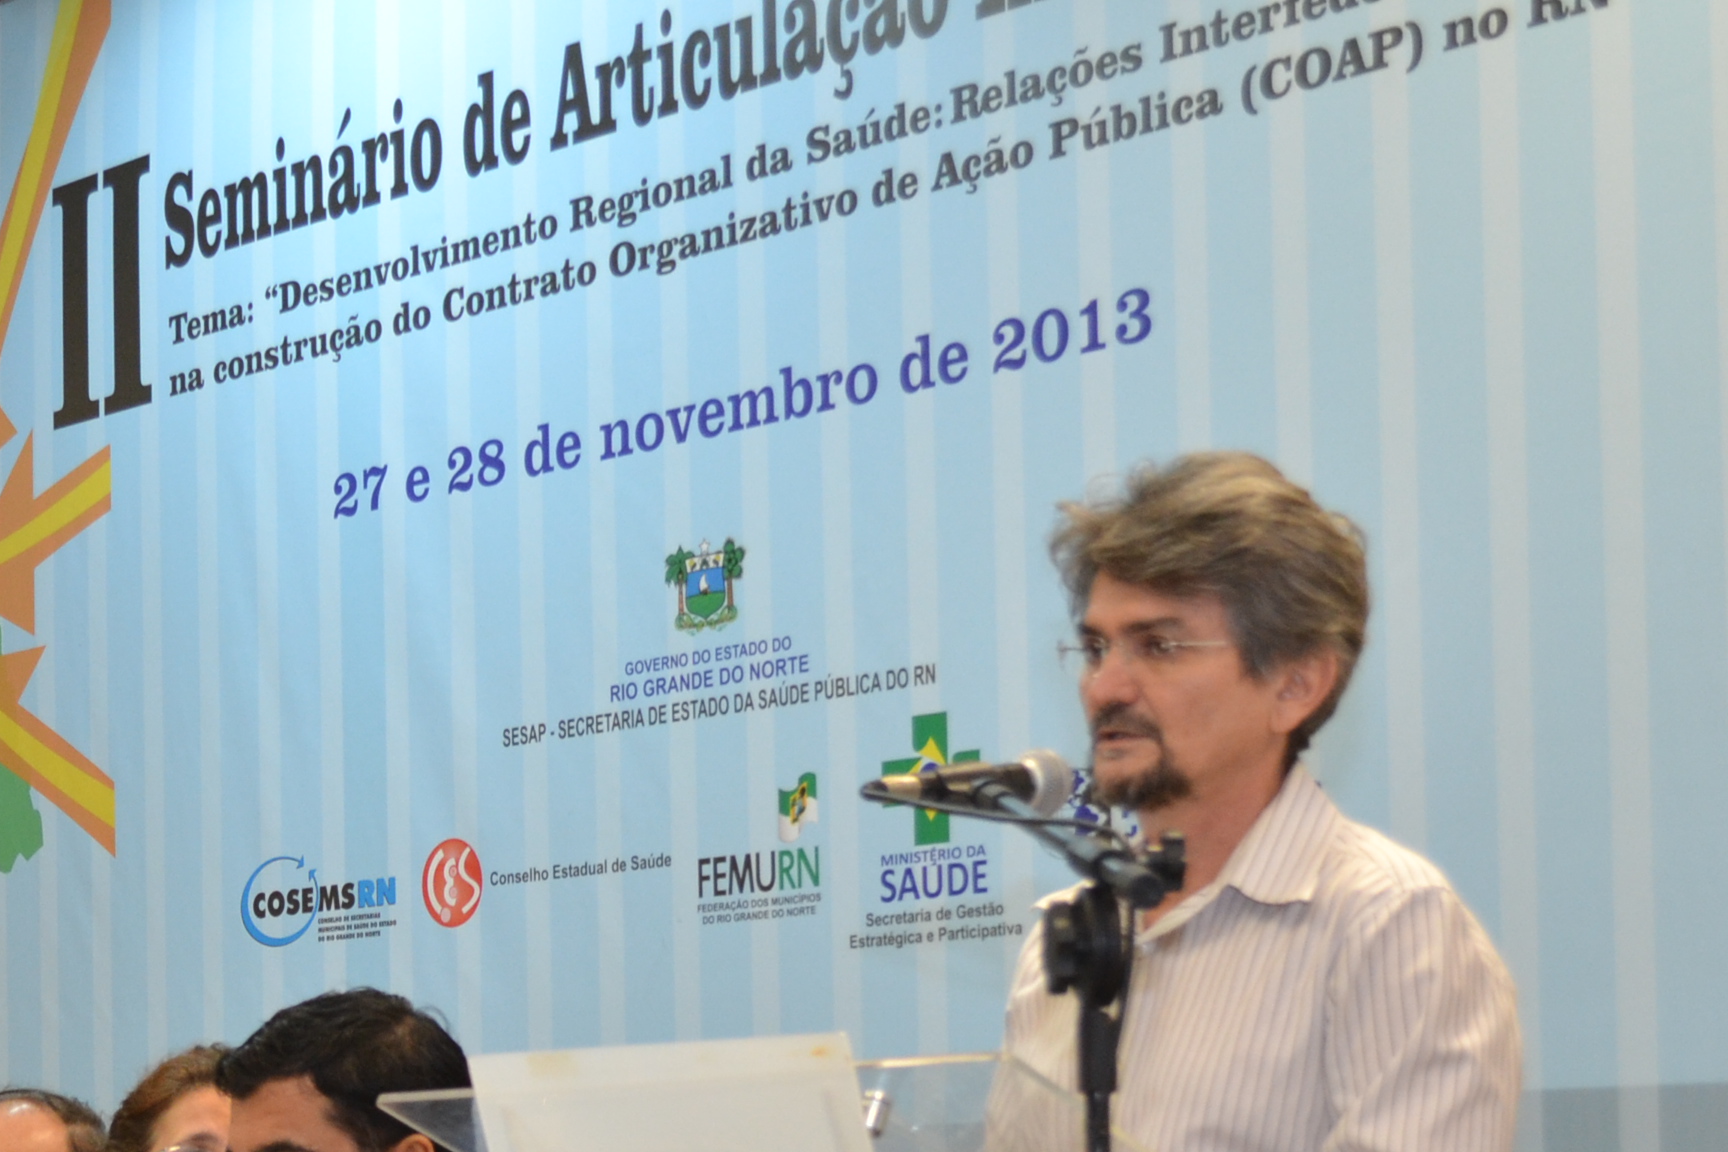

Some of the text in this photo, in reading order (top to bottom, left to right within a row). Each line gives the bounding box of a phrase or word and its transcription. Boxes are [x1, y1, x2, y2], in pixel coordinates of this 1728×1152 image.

[164, 97, 442, 270] Seminário
[463, 70, 531, 178] de
[168, 301, 254, 345] Tema:
[569, 153, 733, 234] Regional
[745, 143, 793, 182] da
[805, 102, 943, 166] Saúde:
[950, 42, 1143, 125] Relações
[1159, 0, 1382, 63] Interfe
[169, 367, 204, 397] na
[213, 313, 383, 384] construção
[393, 301, 431, 336] do
[442, 258, 597, 322] Contrato
[609, 187, 858, 276] Organizativo
[872, 167, 918, 209] de
[931, 135, 1034, 195] Ação
[1048, 87, 1223, 160] Pública
[1241, 20, 1423, 116] (COAP)
[1443, 7, 1509, 51] no
[52, 153, 154, 430] II
[333, 287, 1152, 519] 27 e 28 de novembro de 2013
[624, 635, 792, 676] GOVERNO DO ESTADO DO
[610, 654, 810, 703] RIO GRANDE DO NORTE
[502, 723, 547, 748] SESAP
[558, 708, 645, 740] SECRETARIA
[648, 704, 667, 726] DE
[672, 695, 729, 723] ESTADO
[734, 692, 755, 714] DA
[758, 680, 810, 710] SAÚDE
[814, 672, 882, 701] PÚBLICA
[886, 667, 909, 691] DO
[914, 663, 936, 687] RN
[490, 852, 672, 886] Conselho Estadual de Saúde
[880, 844, 987, 867] MINISTÉRIO DA
[697, 892, 821, 913] FEDERAÇÃO DOS MUNICÍPIOS
[880, 860, 988, 903] SAÚDE
[702, 905, 816, 925] DO RIO GRANDE DO NORTE
[849, 921, 1023, 949] Estratégica e Participativa
[865, 902, 1004, 927] Secretaria de Gestão
